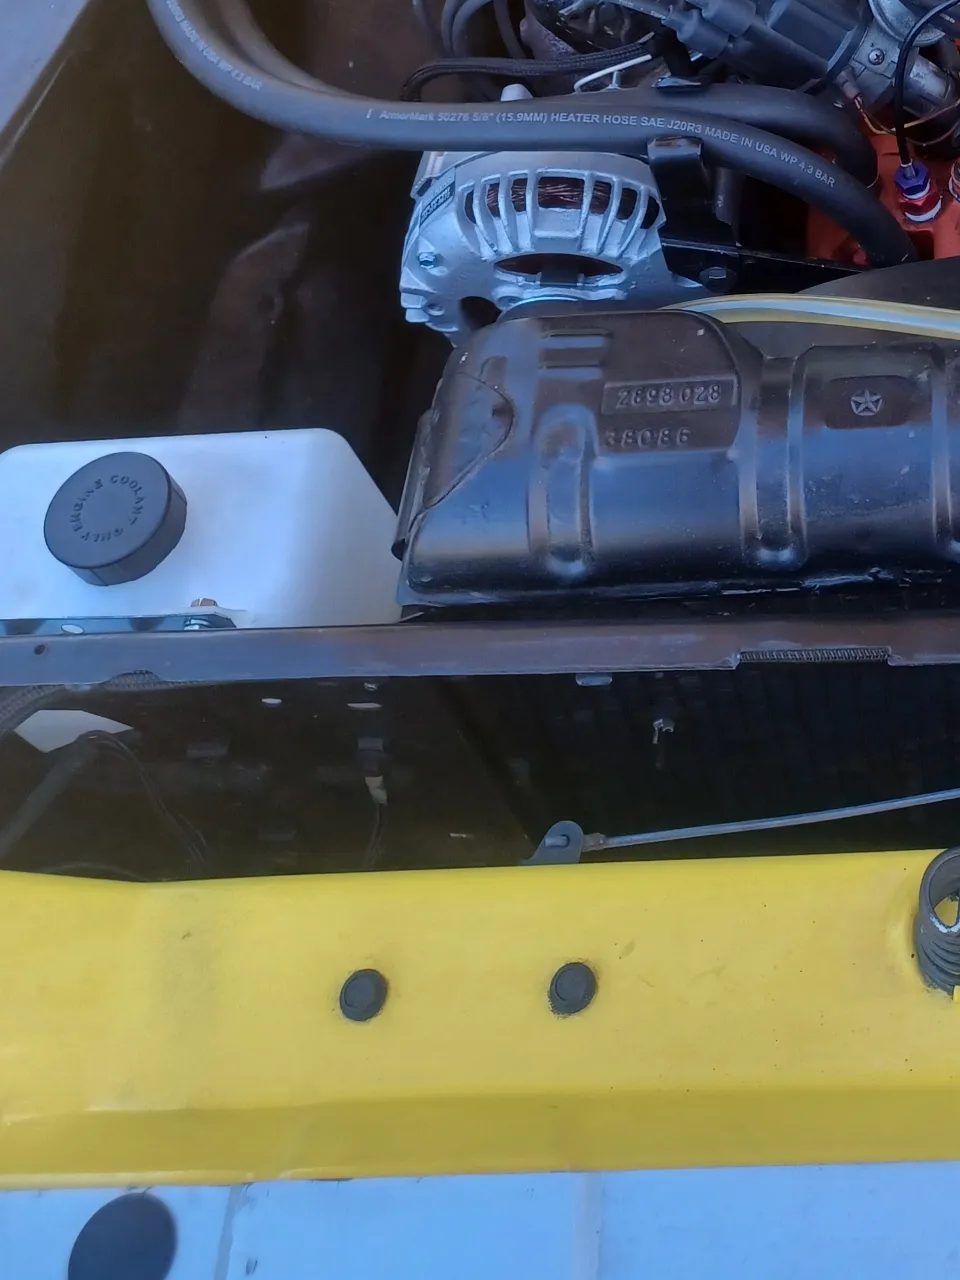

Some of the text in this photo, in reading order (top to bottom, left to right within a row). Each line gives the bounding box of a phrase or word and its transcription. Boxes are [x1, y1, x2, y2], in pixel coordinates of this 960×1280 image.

[379, 109, 434, 122] ArmorMark
[437, 112, 470, 122] 50276
[496, 112, 547, 124] (15.9MM)
[550, 112, 600, 124] HEATER
[603, 114, 637, 126] HOSE
[640, 116, 665, 128] SAE
[667, 117, 702, 134] J20R3
[704, 126, 738, 145] MADE
[741, 136, 753, 148] IN
[754, 141, 778, 158] USA
[779, 151, 798, 165] WP
[798, 161, 814, 175] 4.3
[814, 169, 836, 188] BAR
[110, 474, 147, 526] COOLANT
